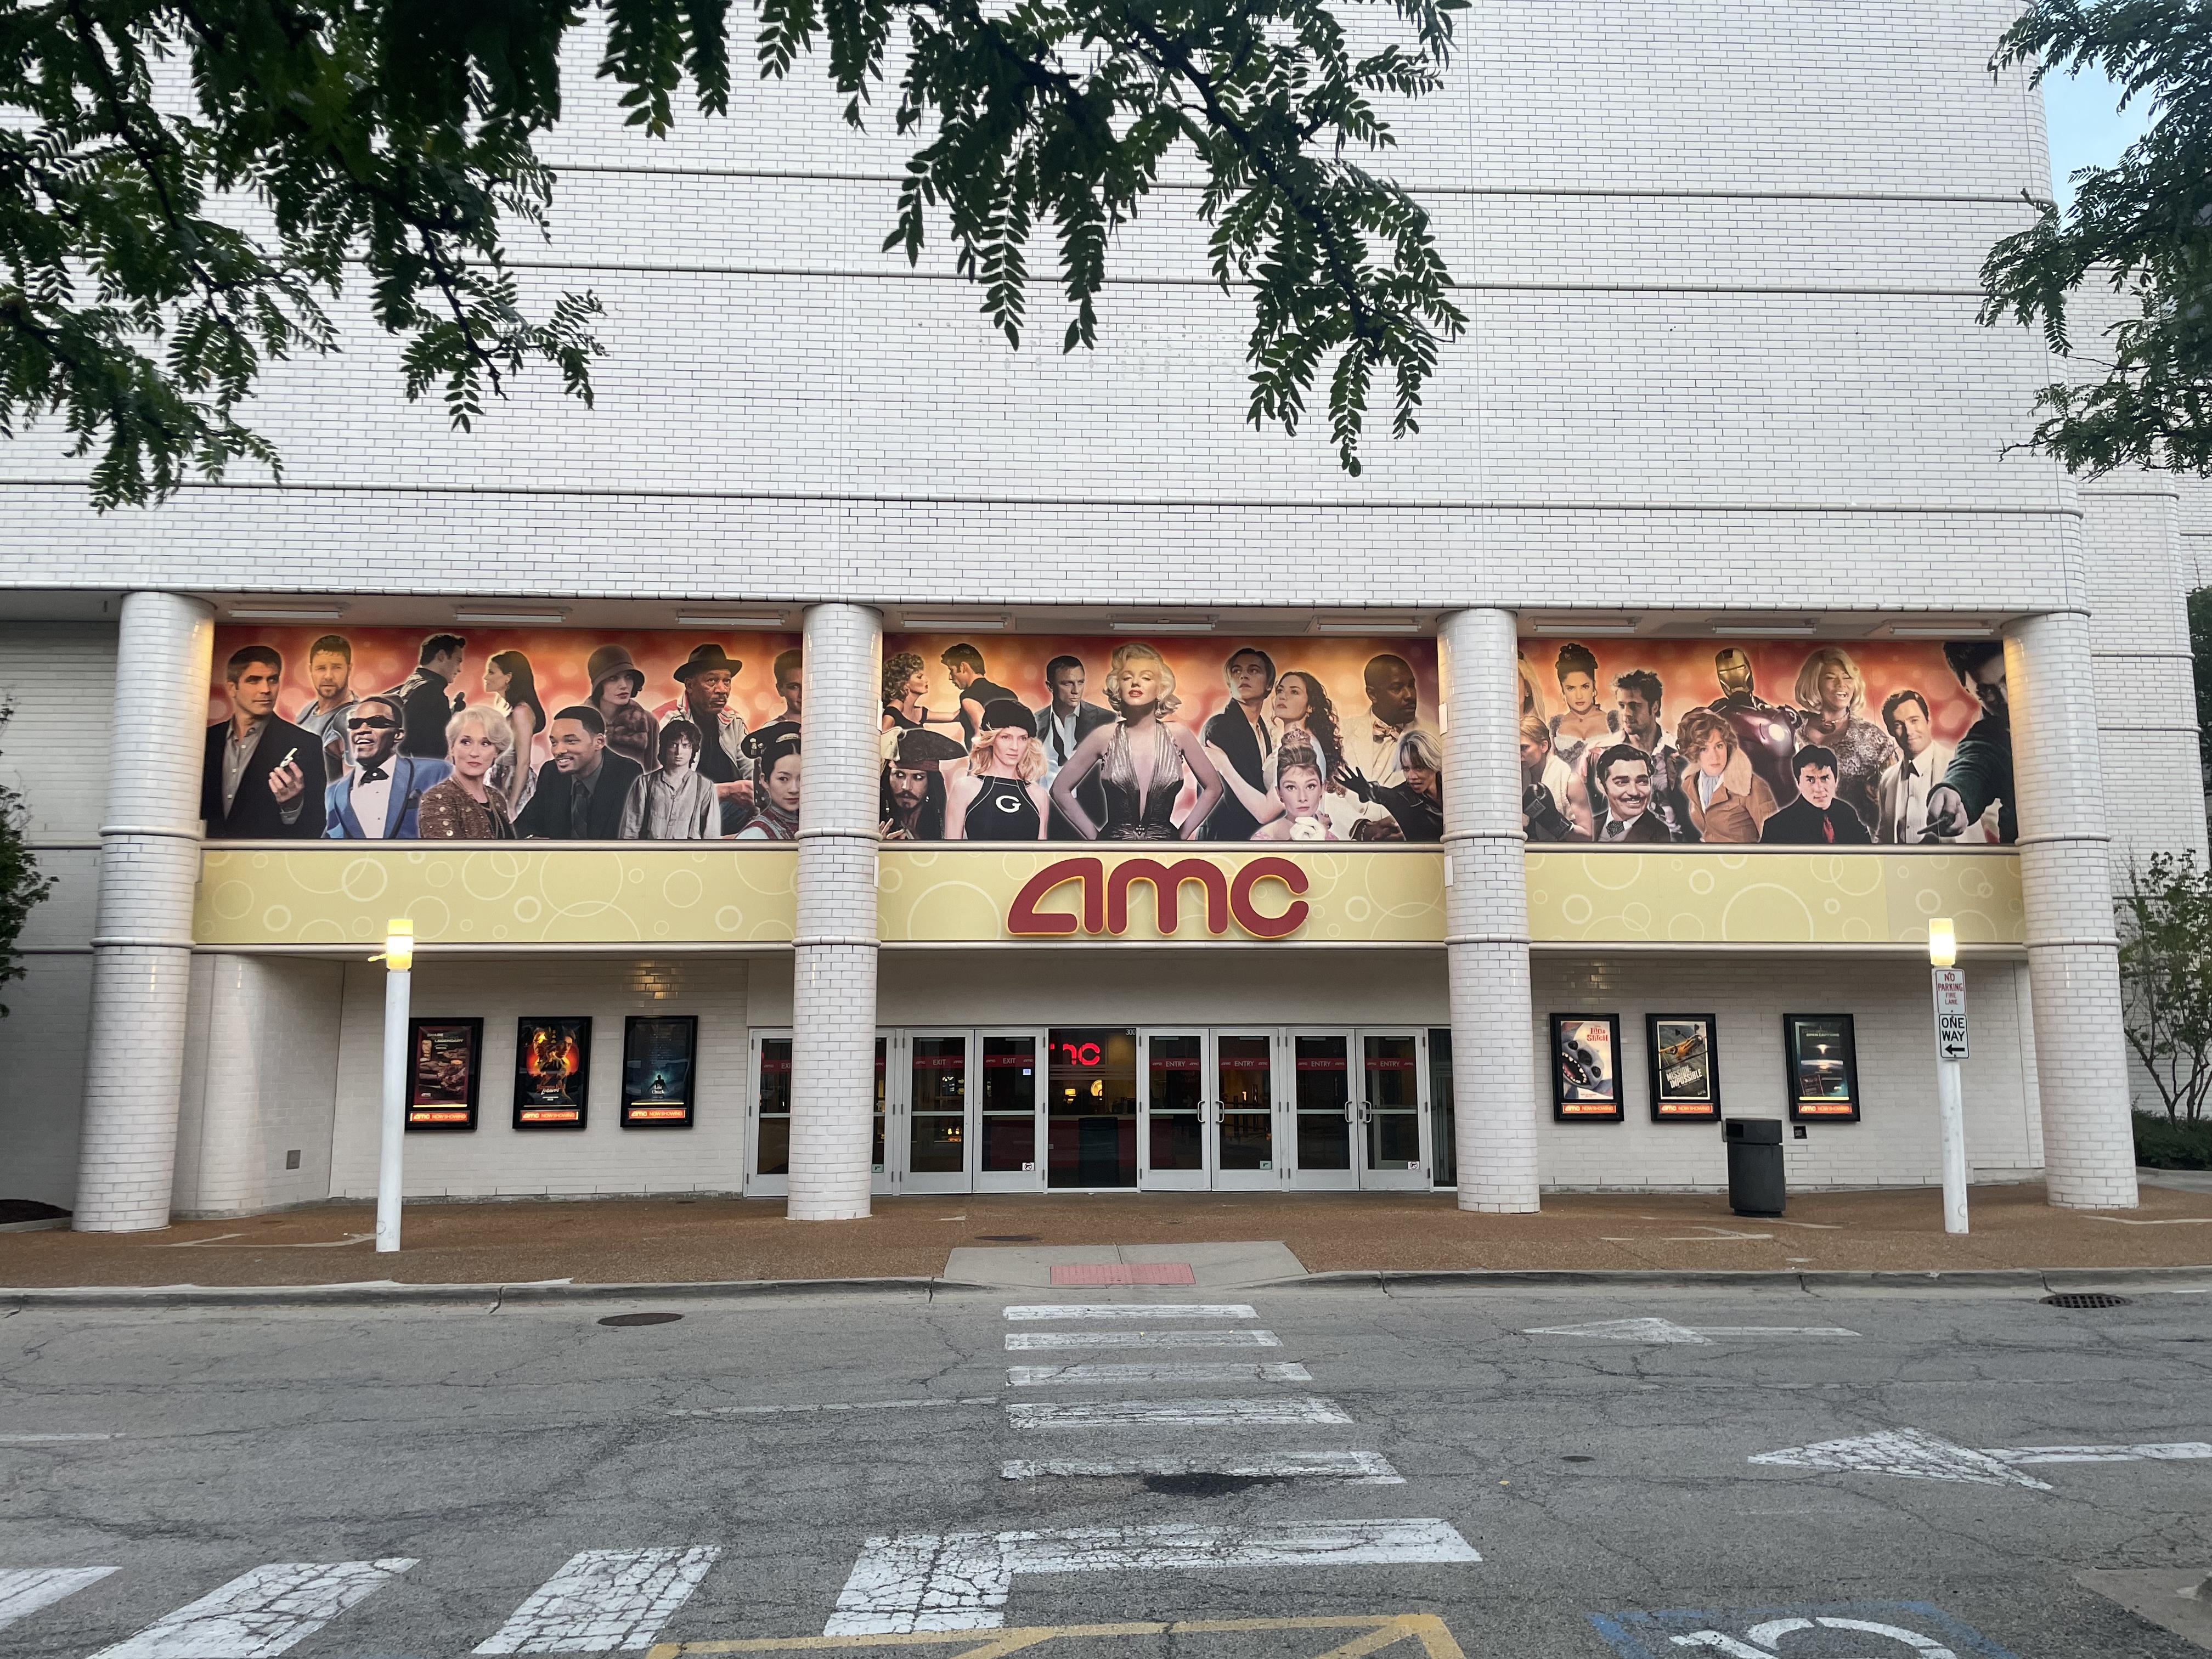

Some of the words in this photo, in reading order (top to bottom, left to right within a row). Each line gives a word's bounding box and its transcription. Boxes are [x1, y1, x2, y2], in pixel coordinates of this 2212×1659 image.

[996, 795, 1022, 813] G
[1944, 973, 1955, 981] NO
[1938, 983, 1963, 991] PARKING
[1942, 1018, 1965, 1029] ONE
[1942, 1030, 1965, 1041] WAY
[1669, 1068, 1702, 1089] IMPOSSIBLE
